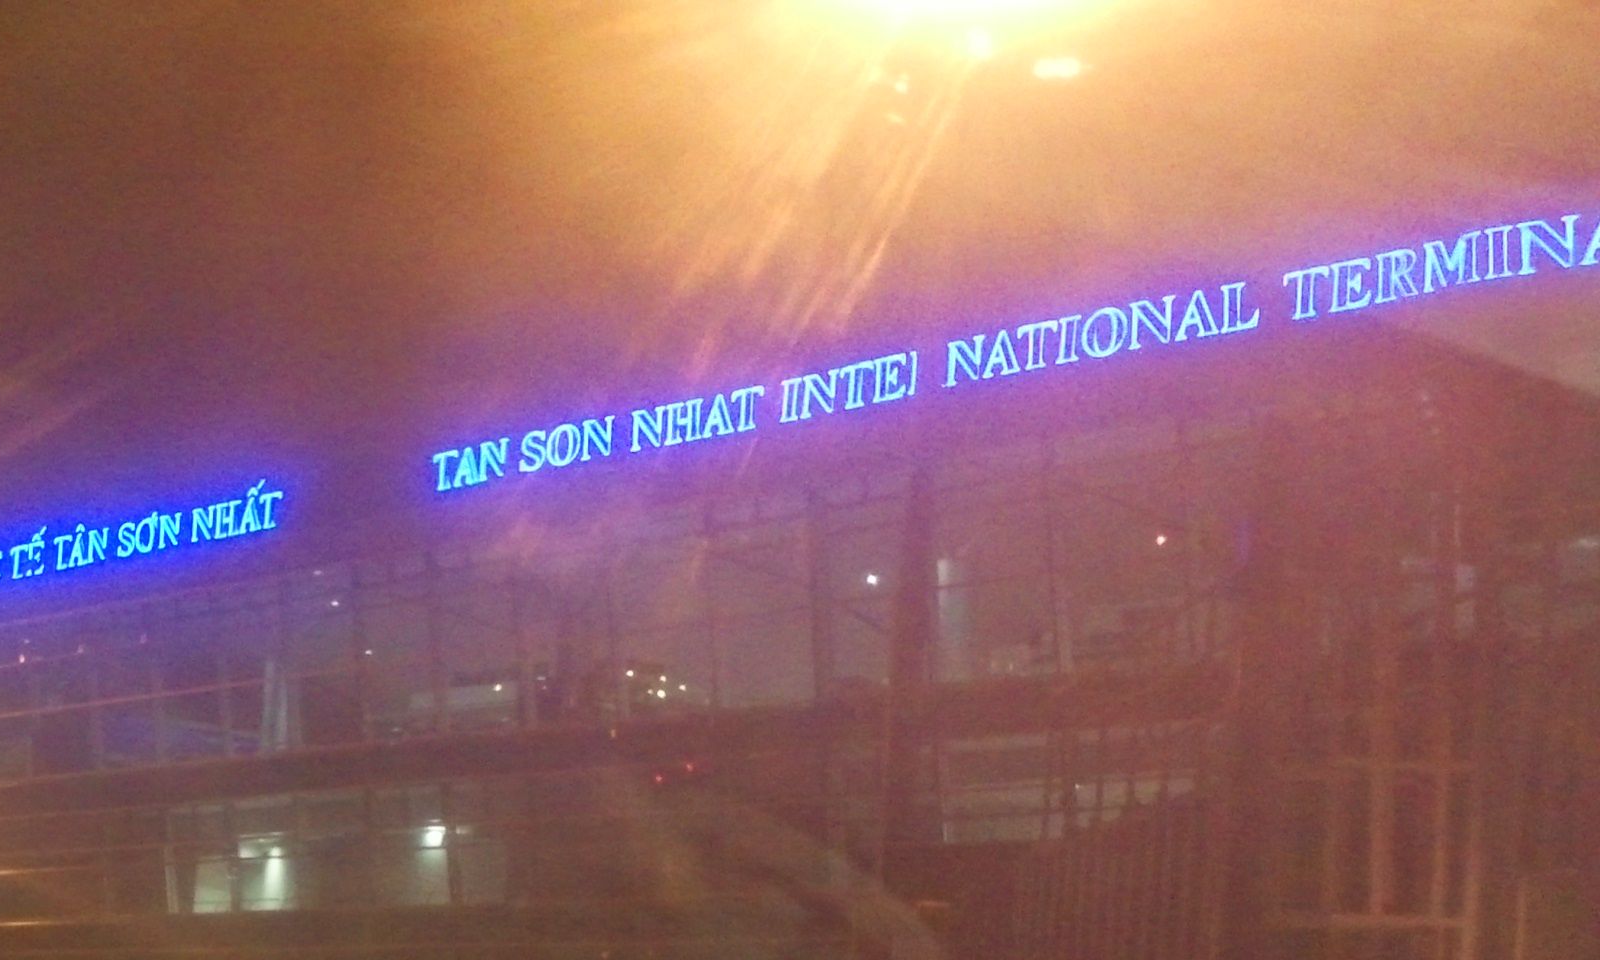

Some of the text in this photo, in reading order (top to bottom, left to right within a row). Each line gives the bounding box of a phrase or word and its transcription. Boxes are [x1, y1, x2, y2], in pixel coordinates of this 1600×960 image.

[432, 438, 510, 491] TAN
[518, 415, 615, 473] SON
[630, 384, 765, 453] NHAT
[9, 524, 48, 580] TẾ
[52, 522, 110, 571] TÂN
[116, 511, 183, 558] SƠN
[190, 478, 284, 543] NHẤT
